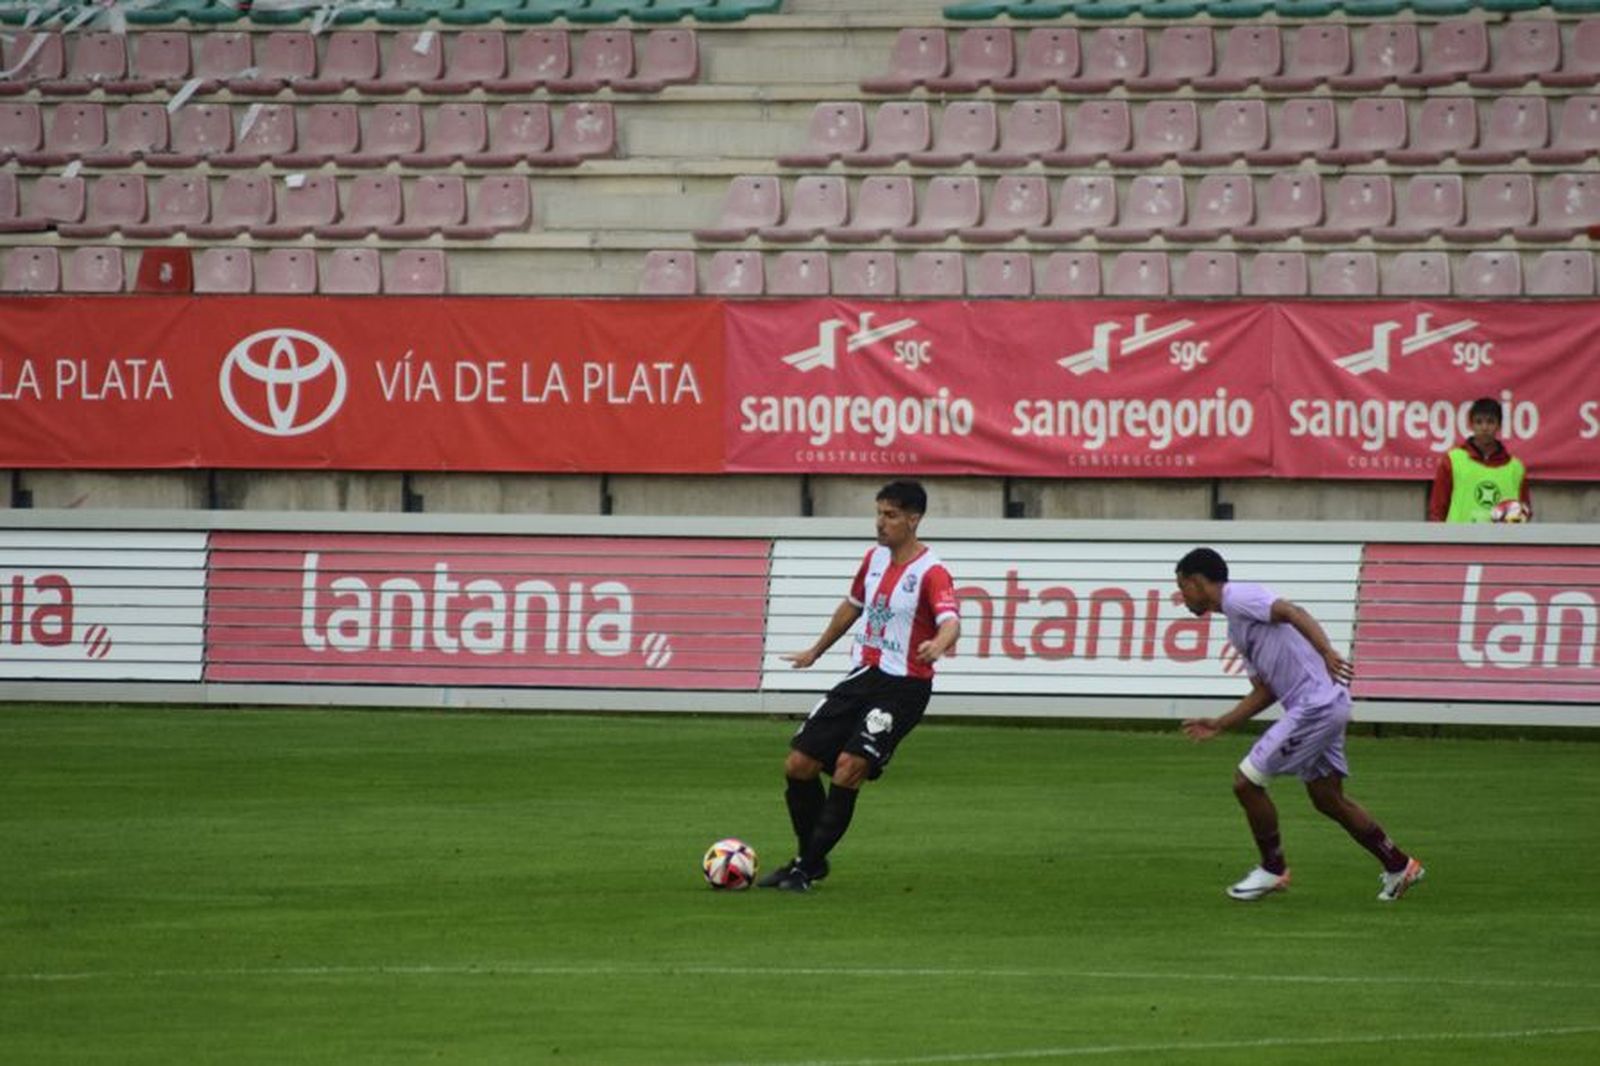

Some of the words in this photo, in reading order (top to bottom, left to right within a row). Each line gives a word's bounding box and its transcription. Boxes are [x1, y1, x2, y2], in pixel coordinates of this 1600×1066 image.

[56, 358, 173, 400] PLATA
[375, 350, 440, 402] VÍA
[455, 360, 506, 403] DE
[522, 362, 569, 403] LA
[583, 361, 701, 404] PLATA
[893, 336, 931, 371] sgc
[1169, 338, 1209, 371] sgc
[1452, 341, 1493, 373] sgc
[740, 386, 974, 447] sangregorio
[1010, 387, 1254, 450] sangregorio
[1289, 389, 1539, 453] sangregoio
[0, 574, 73, 647] ia
[301, 552, 634, 657] lantania
[944, 570, 1211, 662] ntania
